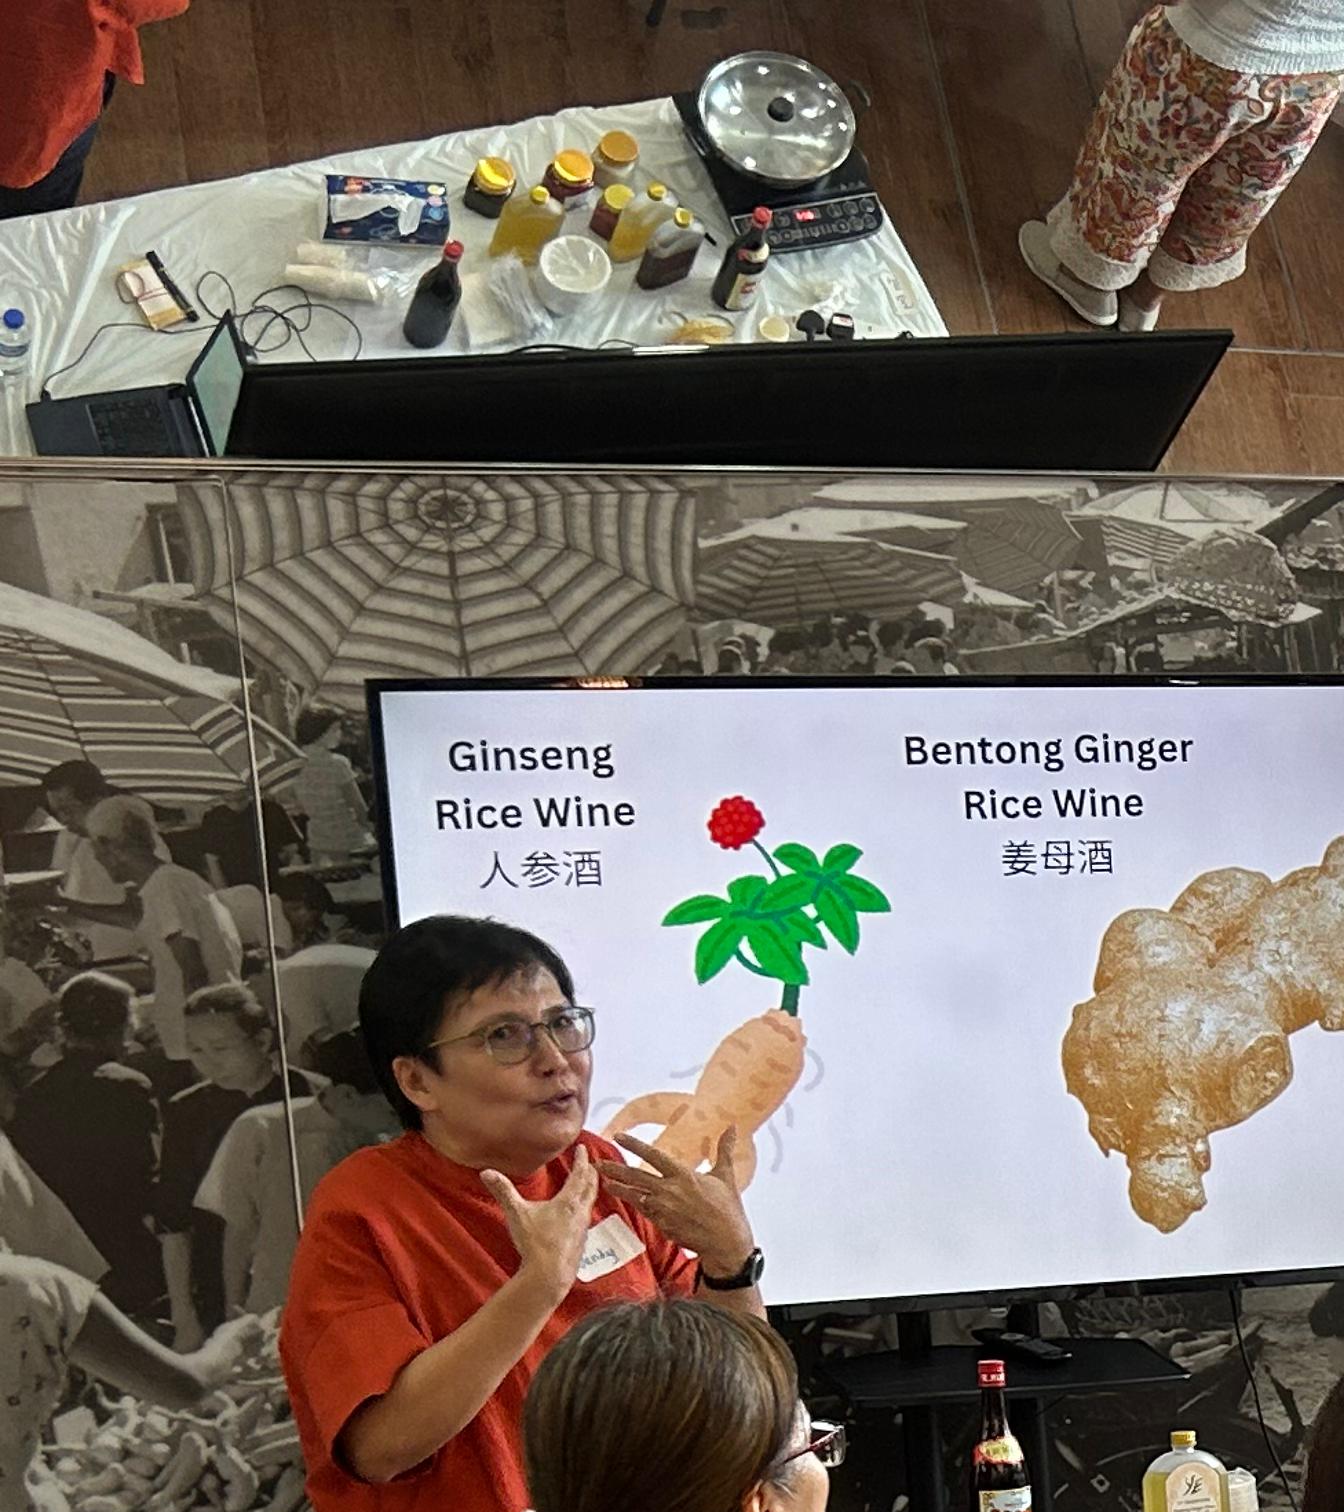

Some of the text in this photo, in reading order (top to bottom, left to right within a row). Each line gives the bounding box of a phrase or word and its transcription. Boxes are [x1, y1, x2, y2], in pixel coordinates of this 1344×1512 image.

[448, 739, 615, 779] Ginseng
[904, 732, 1194, 773] Bentong Ginger
[435, 795, 636, 830] Rice Wine
[964, 787, 1144, 820] Rice Wine
[479, 849, 602, 889] 人参酒
[1002, 839, 1113, 877] 姜母酒
